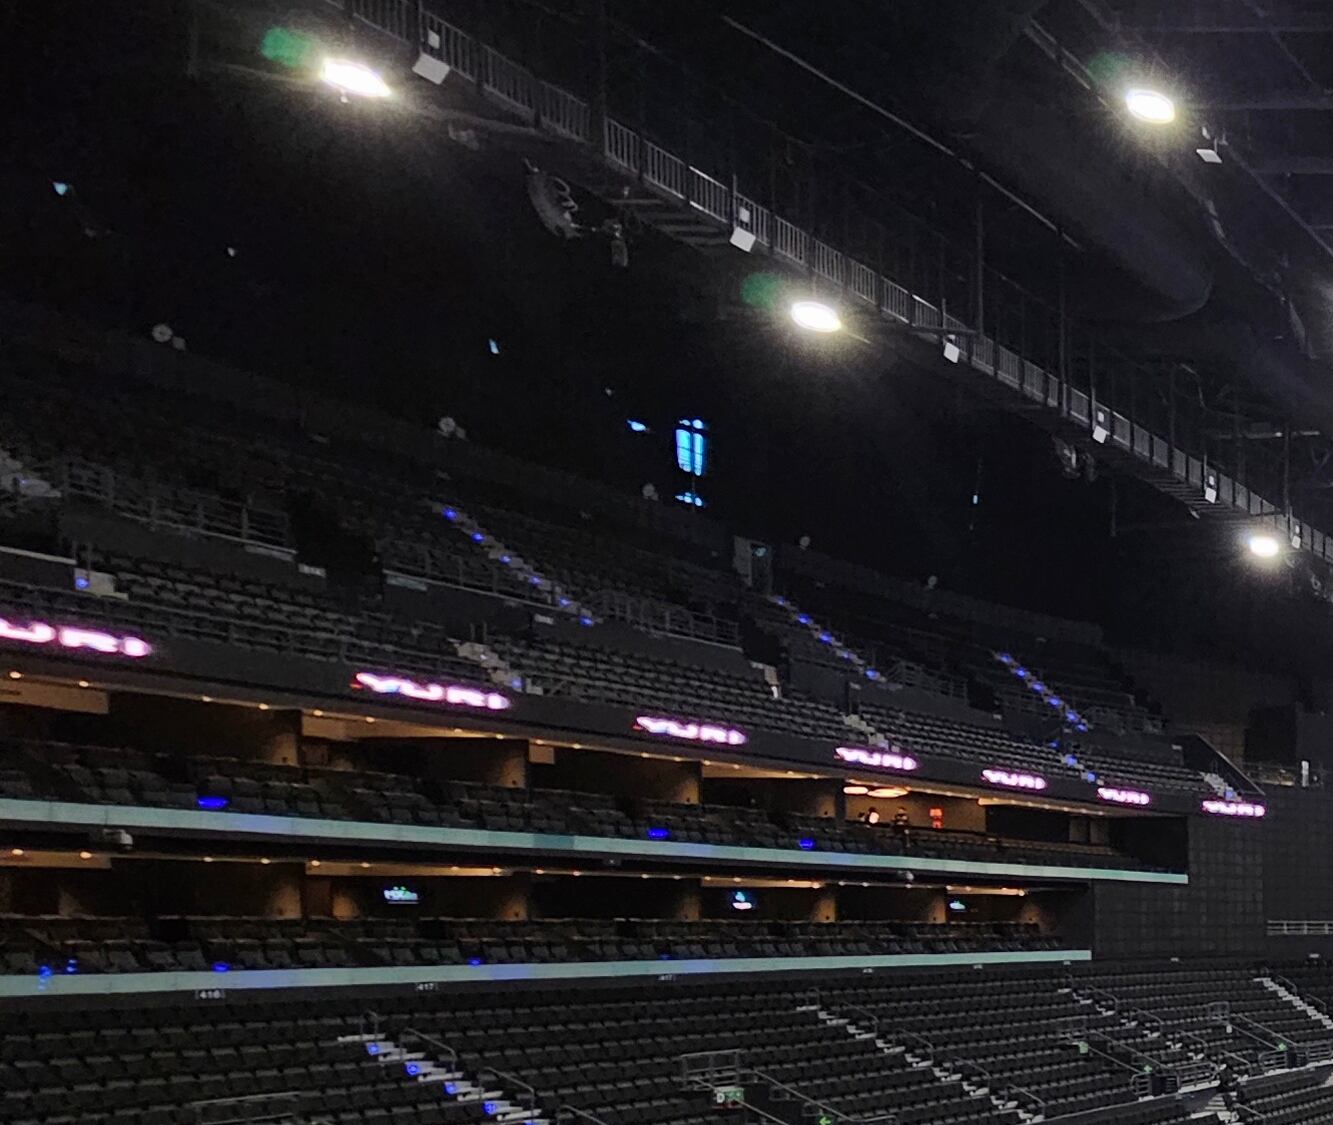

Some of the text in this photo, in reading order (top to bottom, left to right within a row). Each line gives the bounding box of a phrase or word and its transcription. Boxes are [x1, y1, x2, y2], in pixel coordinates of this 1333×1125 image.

[0, 618, 152, 657] URI
[356, 673, 510, 709] YURI
[634, 716, 747, 746] YURI
